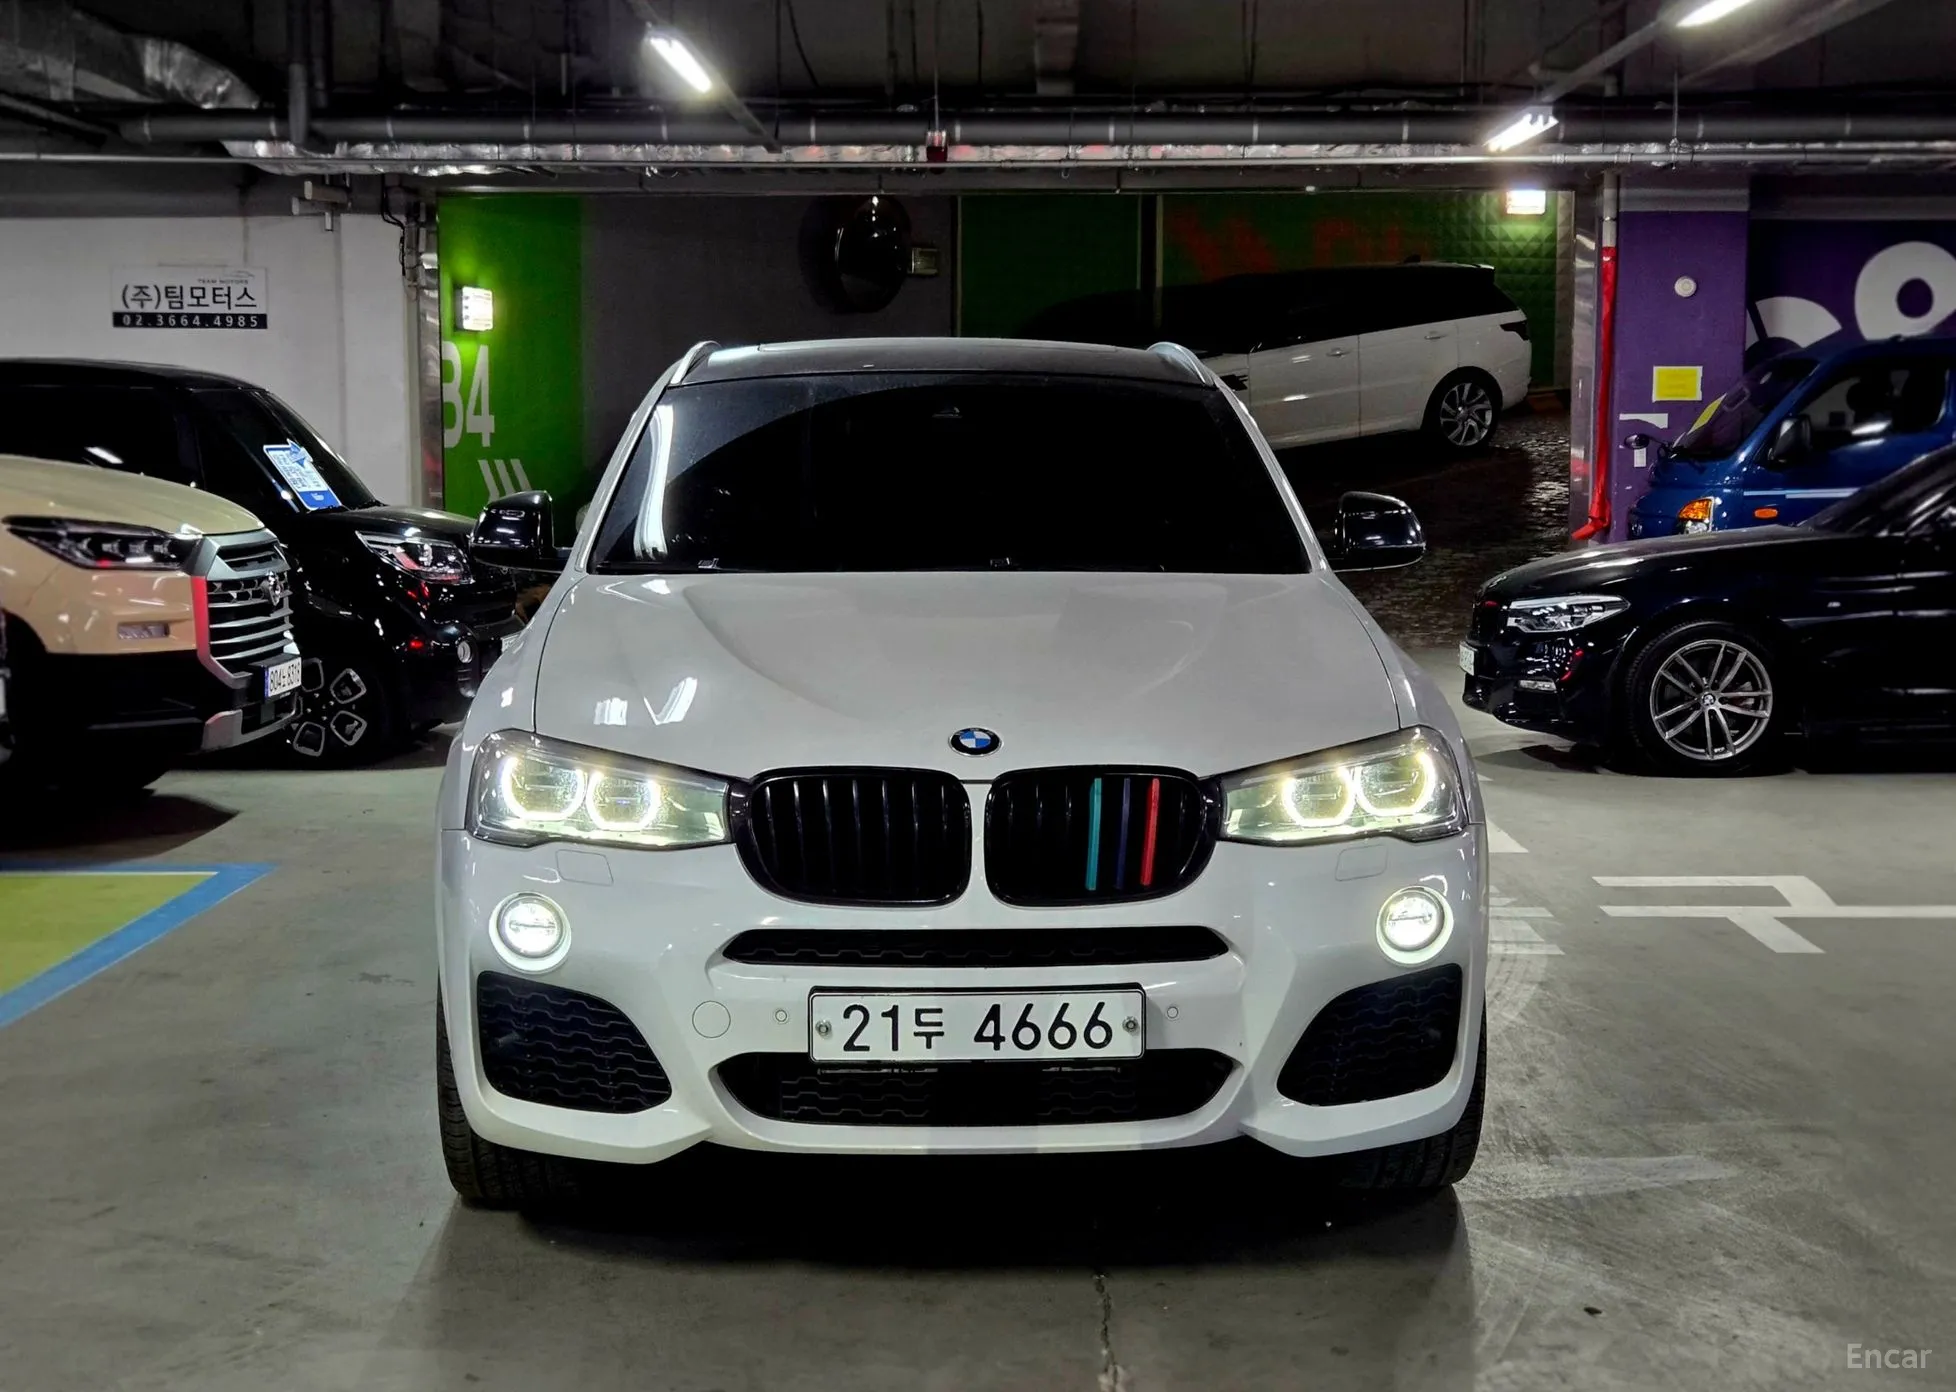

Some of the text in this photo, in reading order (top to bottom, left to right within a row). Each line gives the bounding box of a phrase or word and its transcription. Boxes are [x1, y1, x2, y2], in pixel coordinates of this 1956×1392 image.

[121, 284, 257, 310] (주)팀모터스
[122, 314, 258, 327] 02.3664.4985
[842, 1001, 1113, 1052] 21두 4666
